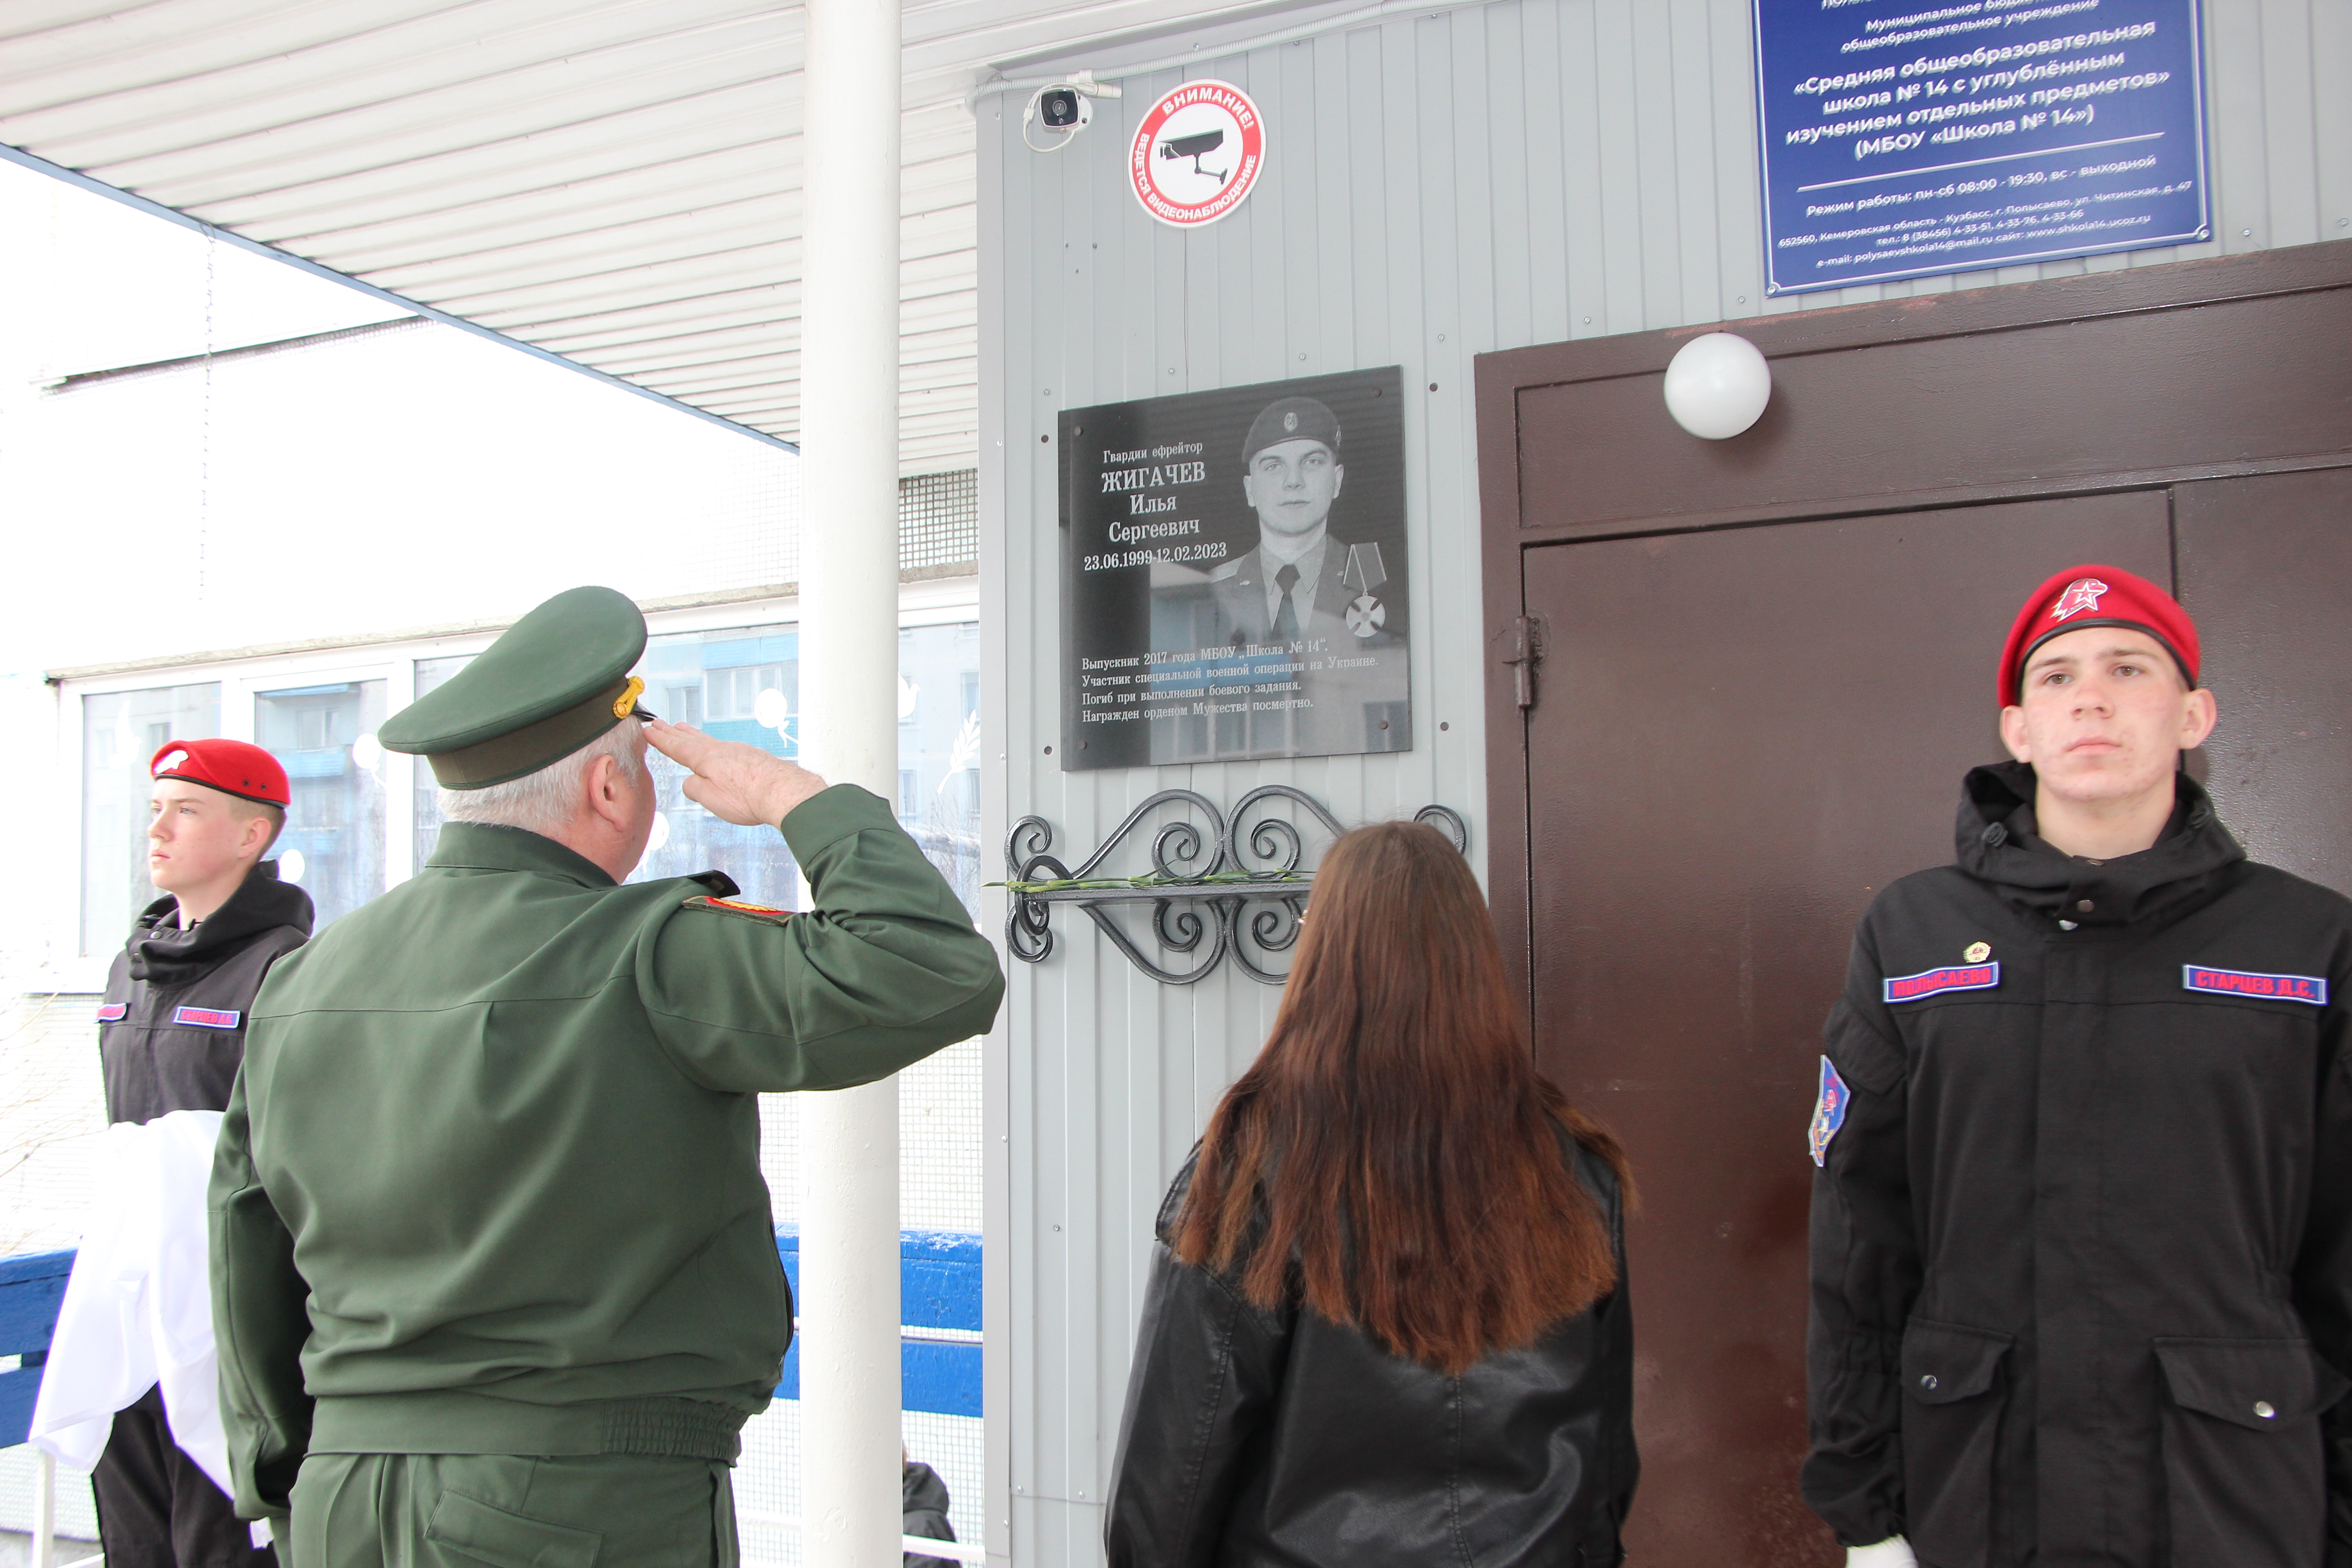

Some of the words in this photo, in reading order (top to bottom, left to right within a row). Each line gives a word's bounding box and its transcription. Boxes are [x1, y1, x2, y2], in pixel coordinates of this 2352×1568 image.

[1842, 15, 2003, 51] общеобразовательное
[2004, 0, 2100, 27] учреждение
[1866, 2, 1983, 33] Муниципальное
[1794, 66, 1896, 94] «Средняя
[1900, 20, 2156, 77] общеобразовательная
[1823, 91, 1891, 114] школа
[1896, 83, 1921, 102] №
[1924, 79, 1949, 98] 14
[1952, 78, 1966, 93] с
[1970, 52, 2126, 94] углублённым
[1162, 87, 1254, 129] ВНИМАНИЕ!
[1786, 113, 1902, 145] изучением
[1907, 93, 2027, 125] отдельных
[2030, 71, 2171, 106] предметов»
[1855, 131, 1926, 161] (МБОУ
[1930, 120, 2016, 143] «Школа
[2021, 112, 2047, 132] №
[2050, 103, 2095, 126] 14»)
[1134, 133, 1152, 195] ВЕДЕТСЯ
[1147, 155, 1257, 220] ВИДЕОНАБЛЮДЕНИЕ
[1807, 201, 1854, 217] Режим
[1857, 192, 1912, 212] работы:
[1914, 184, 1955, 201] пн-сб
[1957, 178, 1997, 196] 08:00
[2009, 172, 2047, 188] 19:30,
[2050, 170, 2068, 180] вс
[2078, 154, 2156, 178] выходной
[1779, 235, 1818, 248] 652560,
[1819, 224, 1891, 243] Кемеровская
[1892, 218, 1937, 232] область
[1945, 210, 1994, 224] Кузбасс,
[2004, 199, 2073, 216] Полысаево,
[2075, 196, 2092, 206] ул.
[2094, 186, 2161, 202] Читинская,
[2164, 184, 2175, 195] д.
[2177, 181, 2192, 191] 47
[1876, 237, 1900, 248] тел.:
[1903, 234, 1910, 244] 8
[1912, 228, 1951, 243] (38456)
[1953, 222, 1994, 237] 4-33-51,
[1996, 215, 2040, 230] 4-33-76,
[2042, 209, 2084, 224] 4-33-66
[1816, 255, 1852, 268] e-mail:
[1854, 236, 1993, 265] polysaevshkola14@mail.ru
[1995, 230, 2024, 244] сайт:
[2027, 214, 2151, 238] www.shkola14.ucoz.ru
[1103, 449, 1147, 463] Гвардии
[1152, 441, 1203, 459] ефрейтор
[1101, 461, 1205, 493] ЖИГАЧЕВ
[1130, 494, 1177, 515] Илья
[1109, 519, 1200, 544] Сергеевич
[1084, 542, 1227, 571] 23.06.1999-12.02.2023
[1082, 657, 1139, 671] Выпускник
[1144, 652, 1167, 665] 2017
[1172, 653, 1196, 663] года
[1200, 646, 1237, 660] МБОУ
[1289, 641, 1303, 654] №
[1082, 675, 1131, 687] Участник
[1135, 667, 1202, 683] специальной
[1206, 663, 1250, 678] военной
[1254, 662, 1304, 675] операции
[1310, 660, 1323, 670] на
[1328, 656, 1378, 668] Украине.
[1082, 691, 1113, 705] Погиб
[1117, 692, 1136, 705] при
[1141, 688, 1205, 701] выполнении
[1209, 683, 1250, 696] боевого
[1255, 681, 1302, 694] задания.
[1082, 709, 1140, 724] Награжден
[1144, 706, 1188, 720] орденом
[1193, 702, 1248, 715] Мужества
[1253, 698, 1314, 711] посмертно.
[1892, 967, 1991, 997] ПОЛЫСАЕВО
[2195, 970, 2275, 994] СТАРЦЕВ
[2275, 979, 2316, 998] Д.С.
